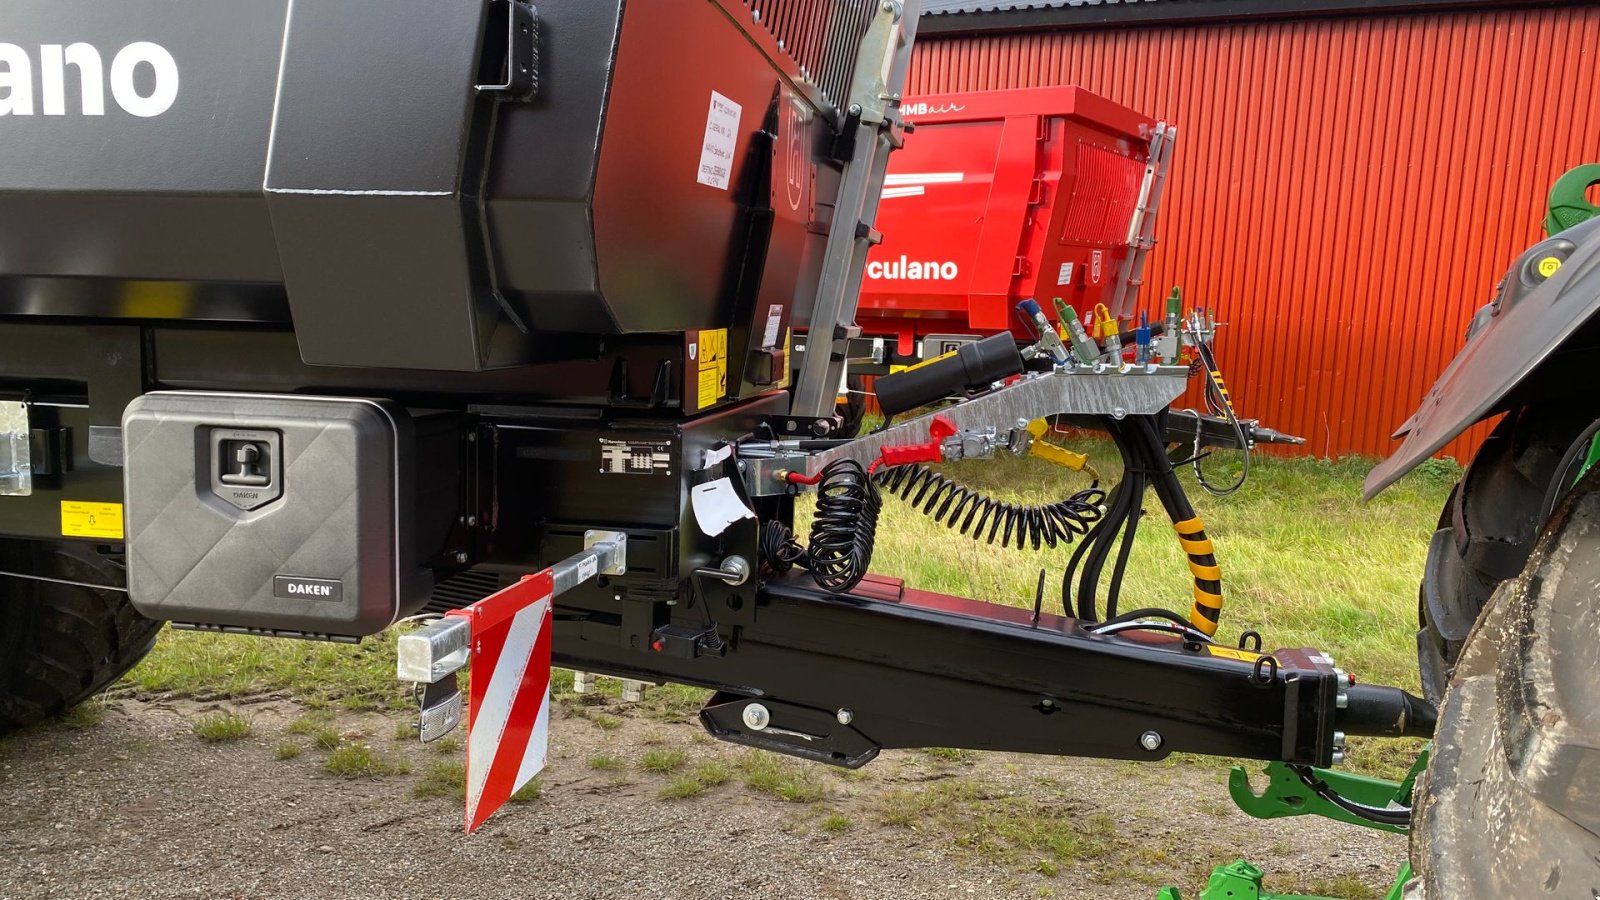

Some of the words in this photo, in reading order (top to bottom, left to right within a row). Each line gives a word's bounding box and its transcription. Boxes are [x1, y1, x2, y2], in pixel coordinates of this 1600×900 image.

[0, 41, 179, 117] ano
[865, 255, 958, 280] culano
[287, 583, 331, 595] DAKEN
